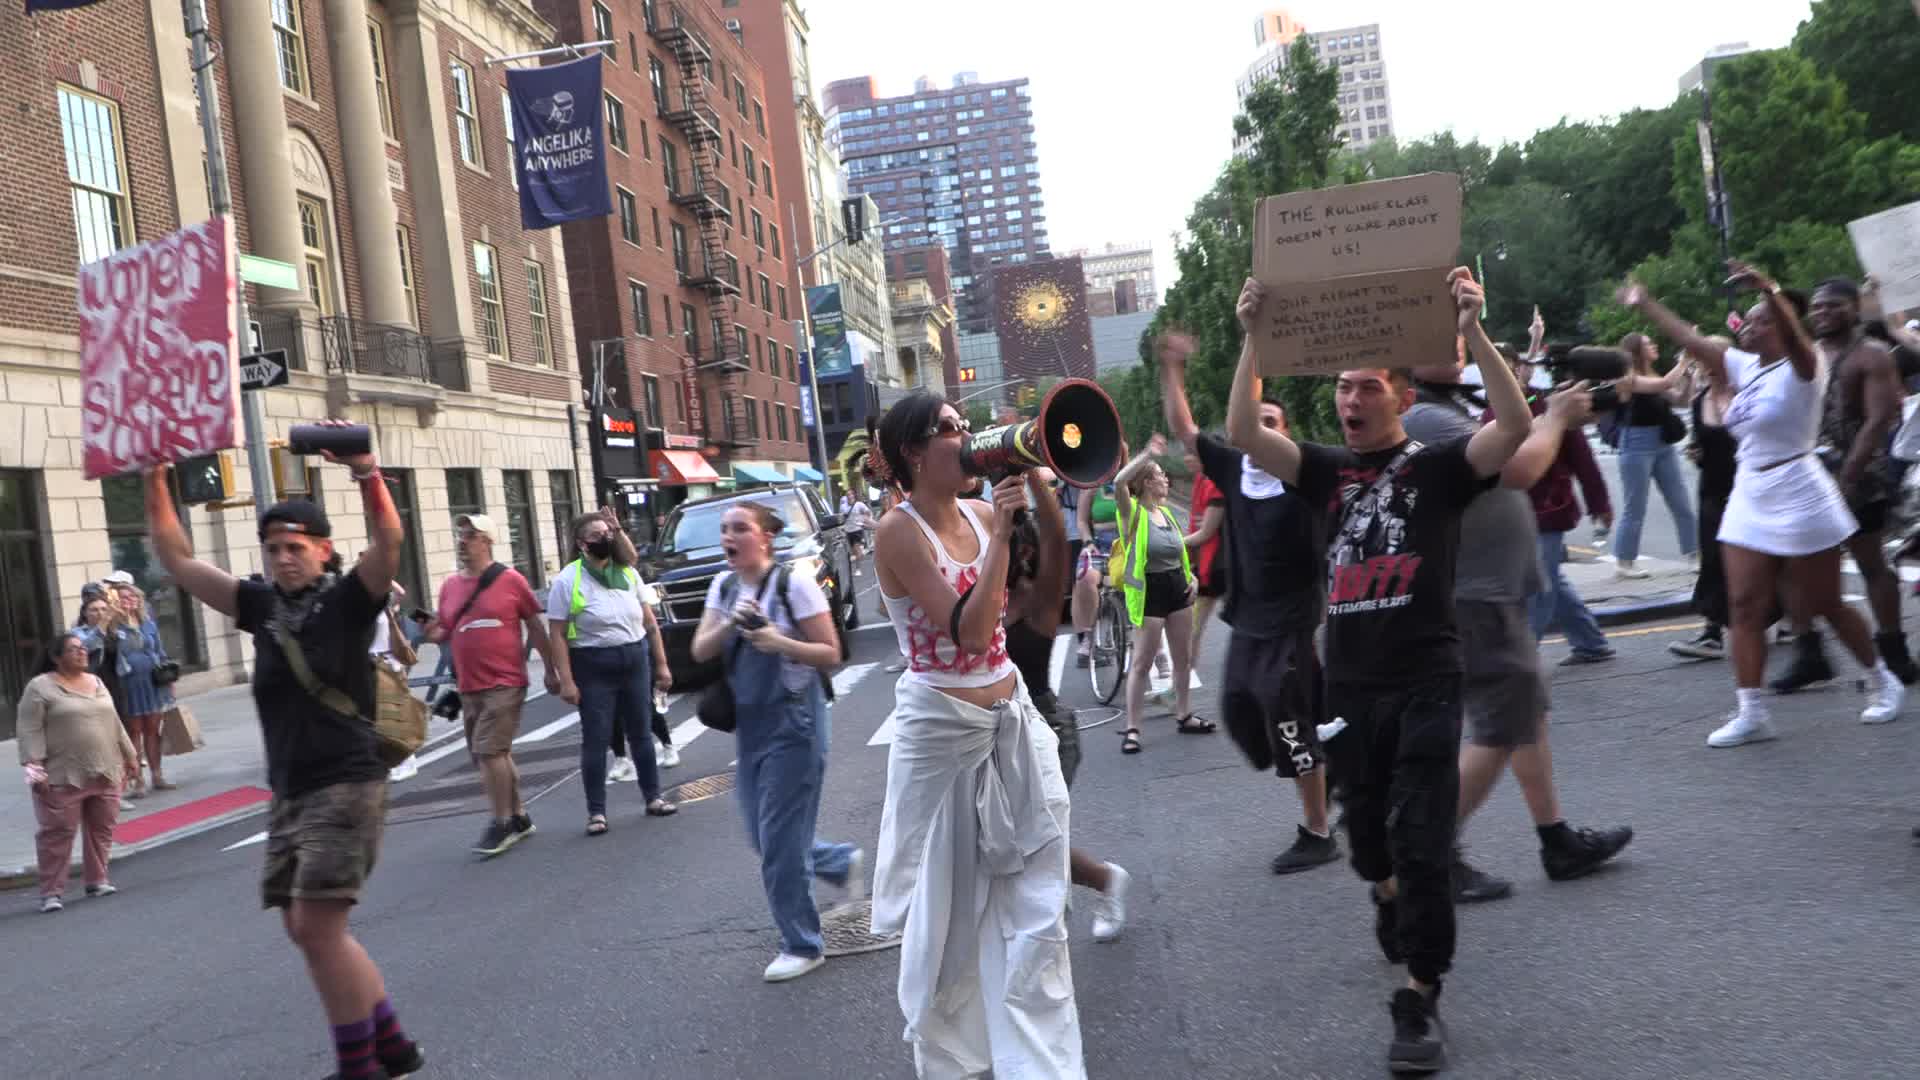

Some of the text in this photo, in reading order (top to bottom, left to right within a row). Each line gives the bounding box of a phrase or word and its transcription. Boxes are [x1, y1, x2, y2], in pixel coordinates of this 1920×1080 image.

[524, 127, 592, 153] ANGELIKA
[525, 147, 593, 171] ANYWHERE
[1279, 206, 1314, 224] THE
[1276, 225, 1336, 245] DOESN'T
[1387, 212, 1440, 228] ABOUT
[1331, 241, 1360, 256] US!
[243, 364, 273, 380] WAY
